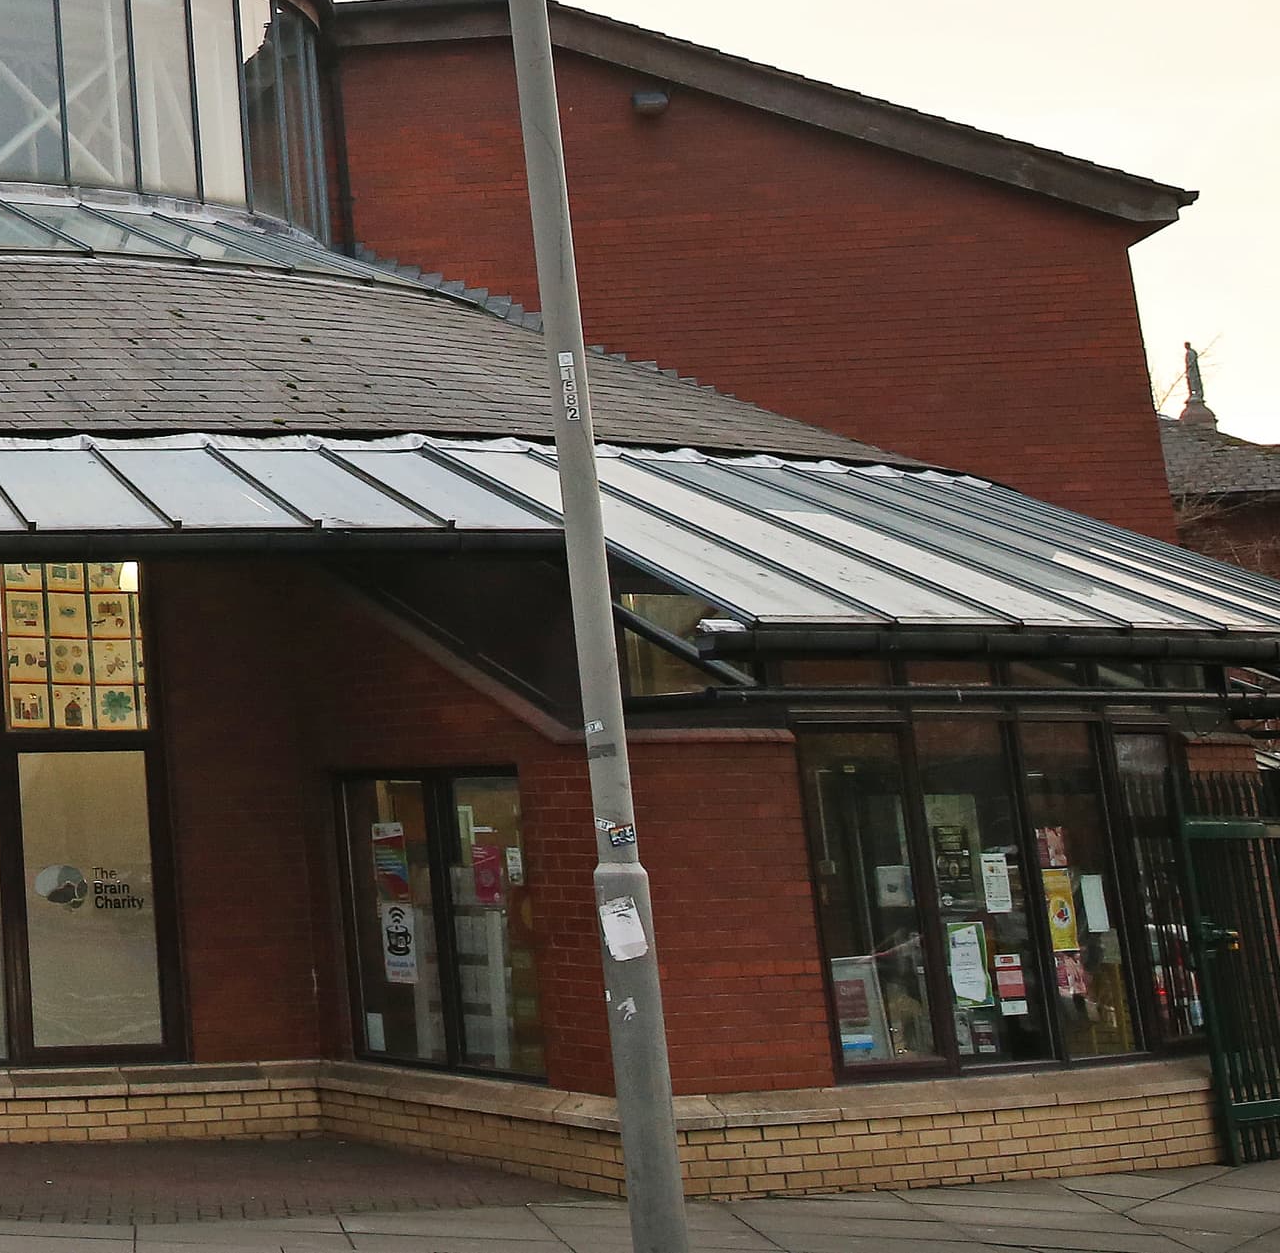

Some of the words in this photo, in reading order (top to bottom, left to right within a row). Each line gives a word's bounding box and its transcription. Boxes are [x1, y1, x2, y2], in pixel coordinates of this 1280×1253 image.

[92, 867, 117, 879] The
[94, 881, 129, 894] Brain
[95, 896, 144, 909] Charity
